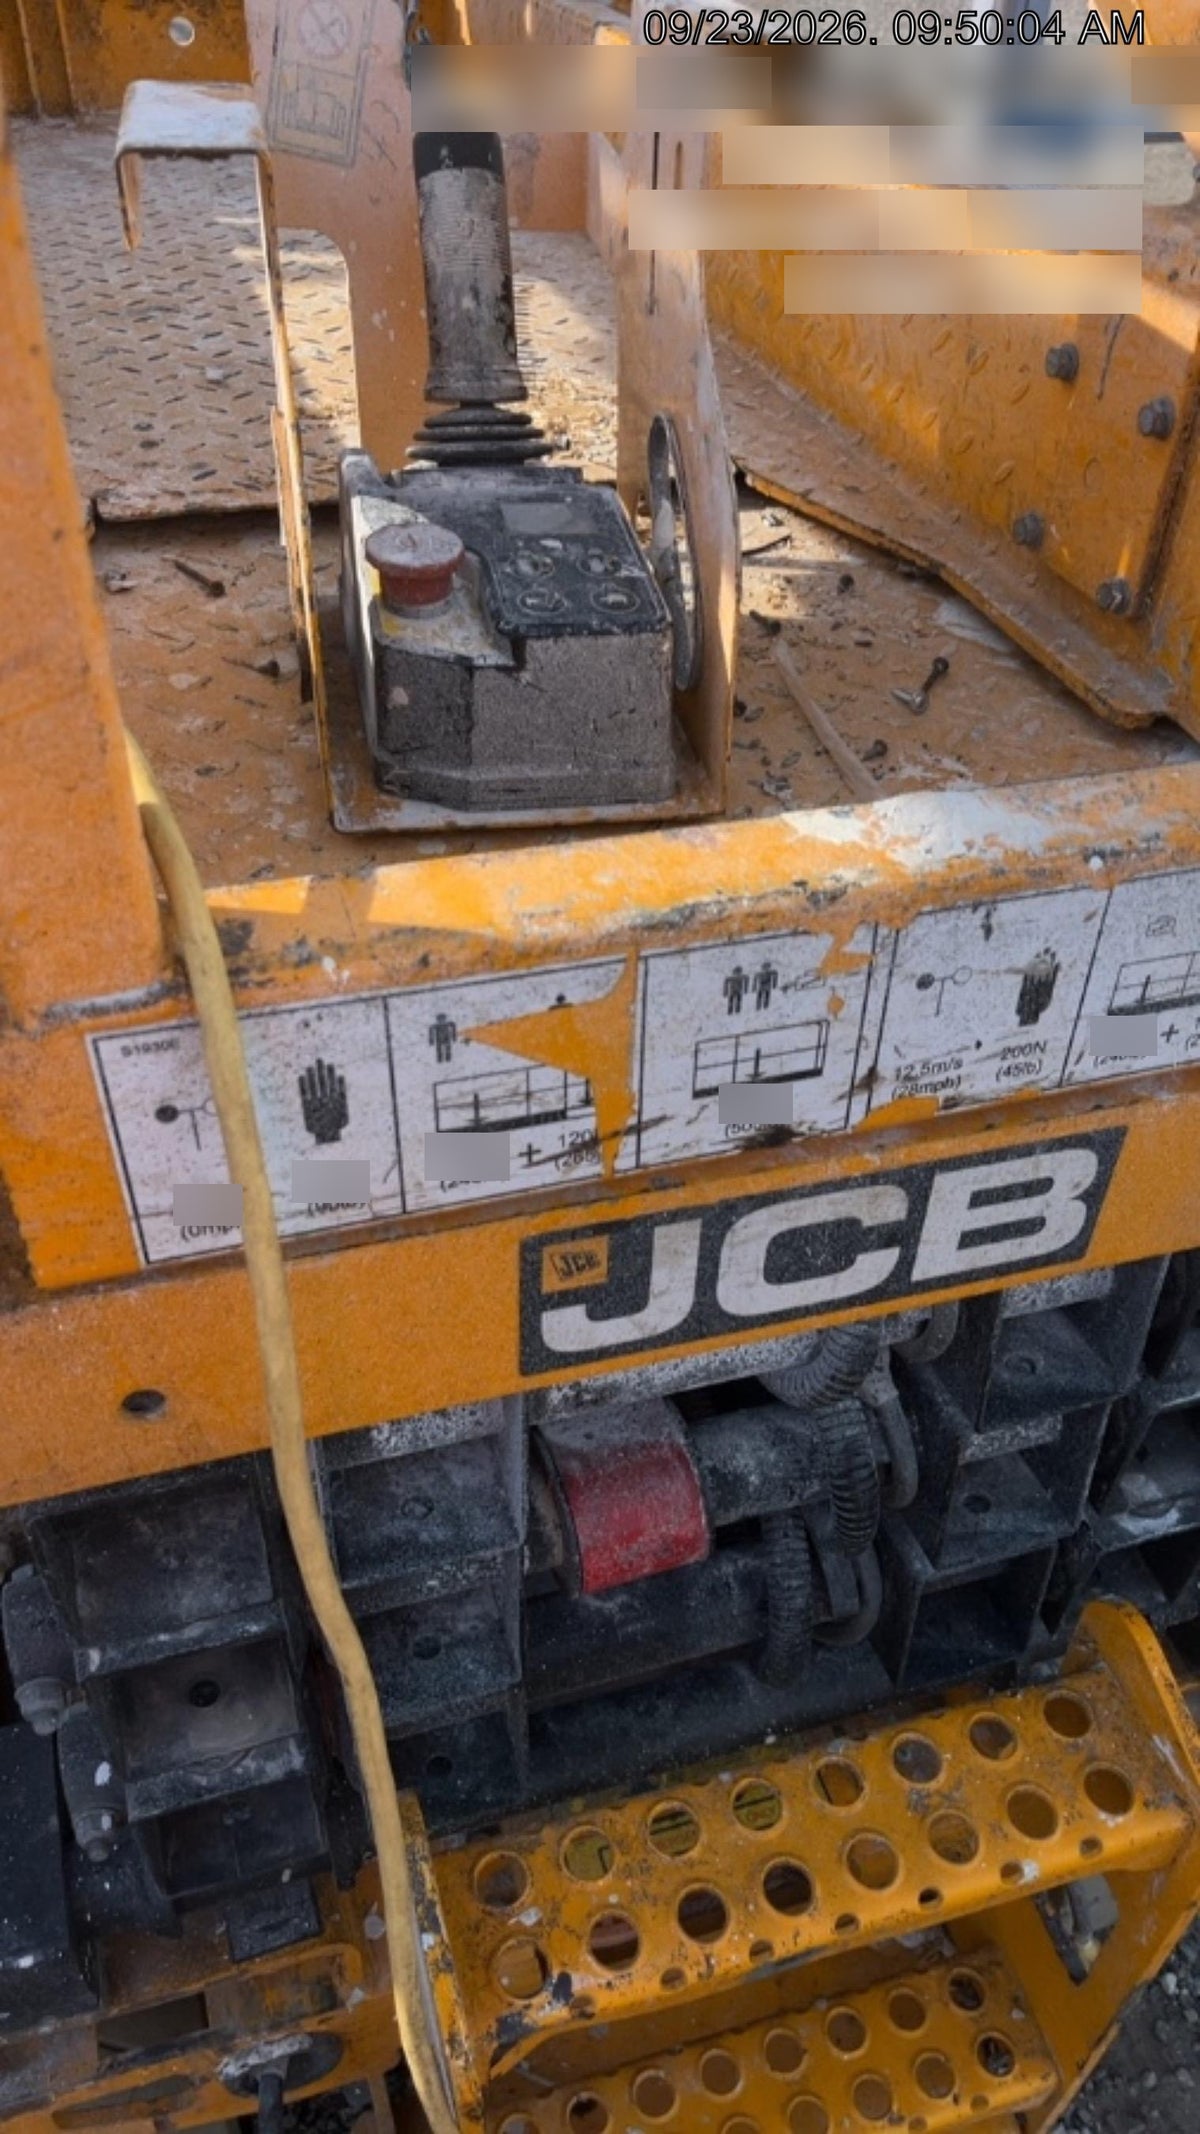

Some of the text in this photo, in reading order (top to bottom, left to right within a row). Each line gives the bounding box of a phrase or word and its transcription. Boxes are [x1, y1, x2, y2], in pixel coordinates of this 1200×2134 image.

[1000, 1040, 1048, 1061] 200N
[996, 1059, 1043, 1082] (45lb)
[540, 1148, 1099, 1353] JCB
[556, 1251, 601, 1280] JCB
